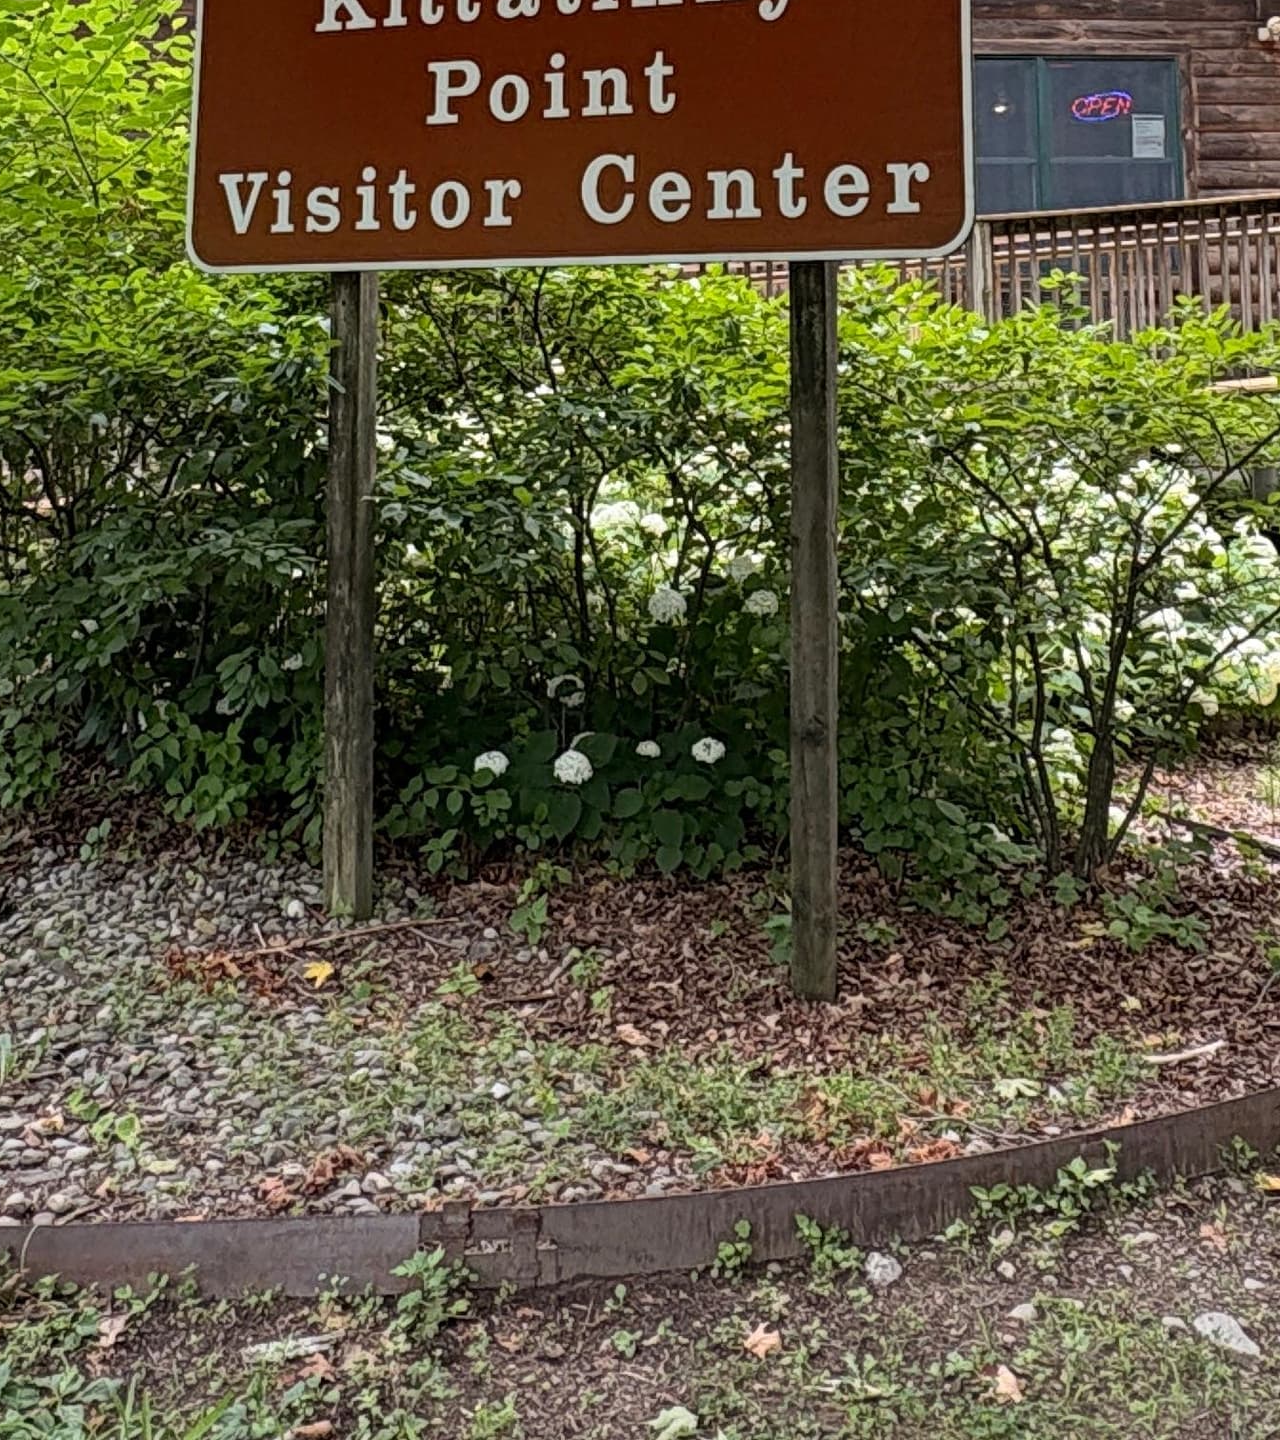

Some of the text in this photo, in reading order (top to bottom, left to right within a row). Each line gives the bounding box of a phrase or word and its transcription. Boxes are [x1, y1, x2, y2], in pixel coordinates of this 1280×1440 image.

[426, 52, 676, 125] Point
[1071, 95, 1132, 115] OPEN
[219, 152, 930, 235] Visitor Center
